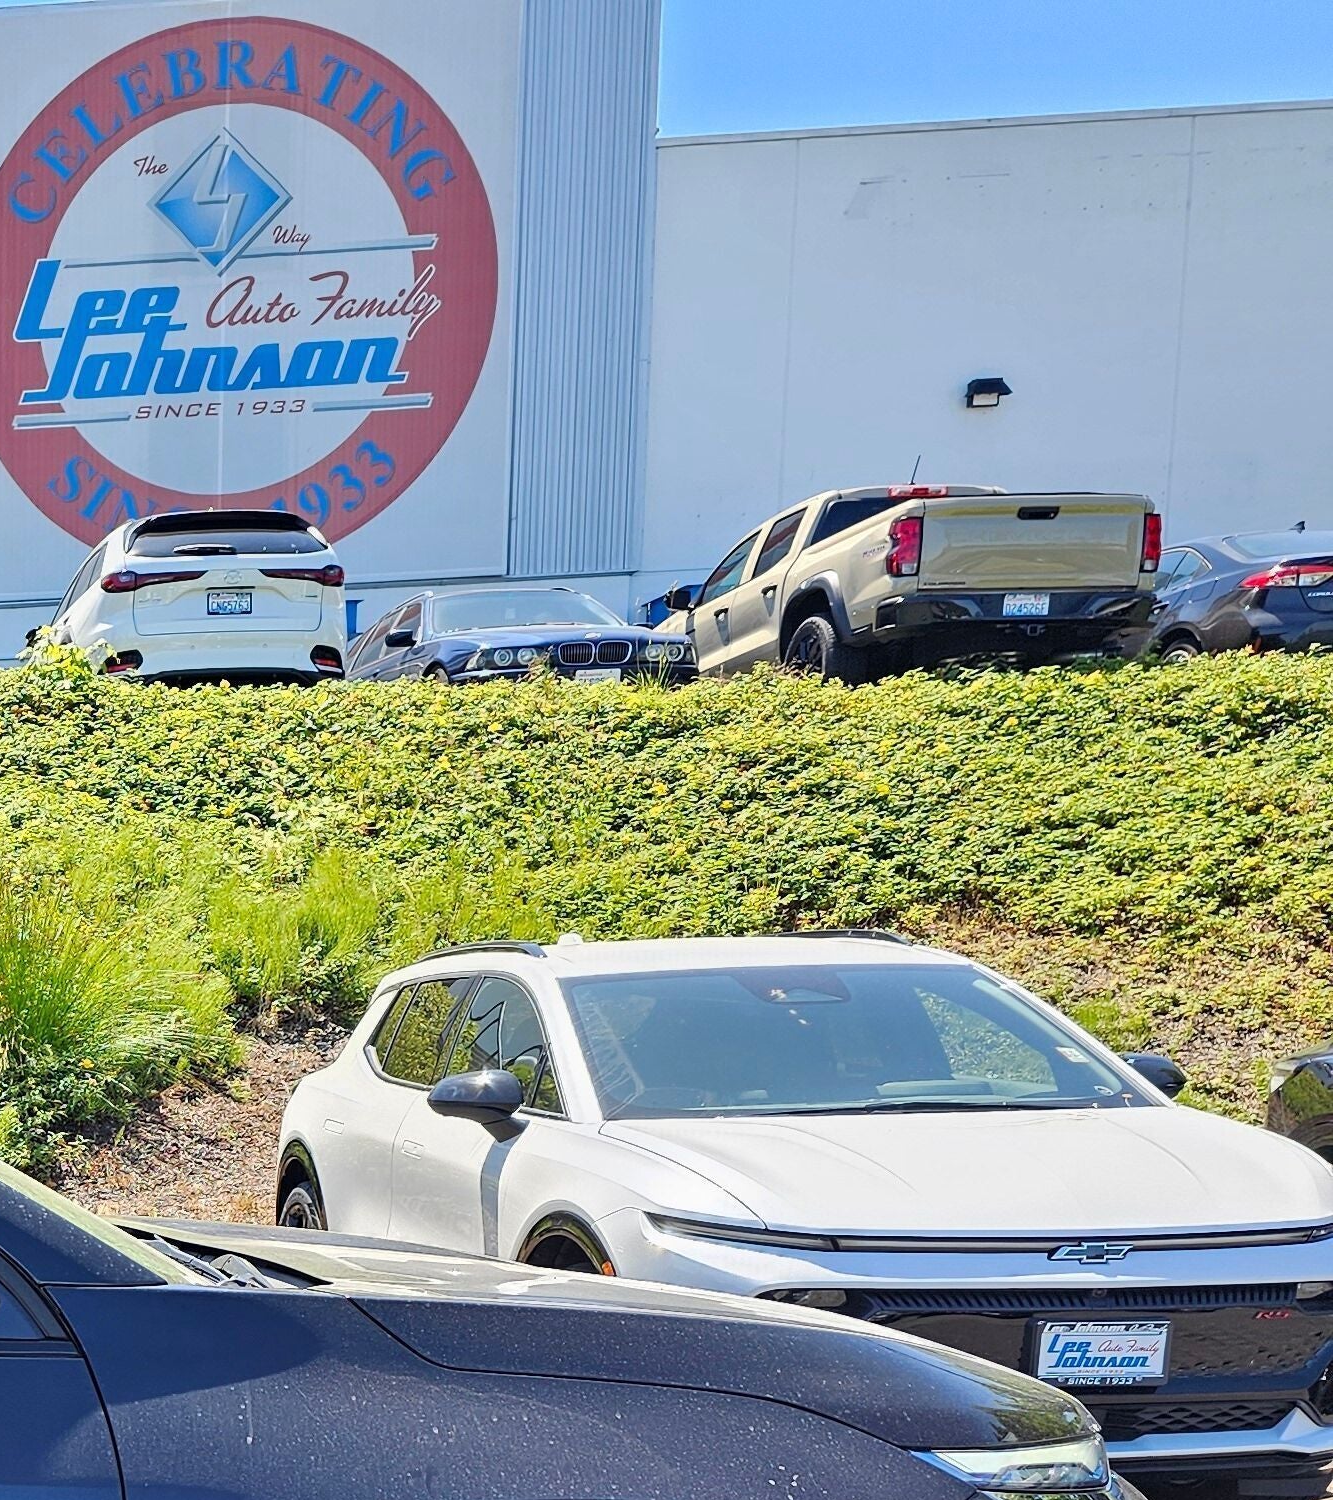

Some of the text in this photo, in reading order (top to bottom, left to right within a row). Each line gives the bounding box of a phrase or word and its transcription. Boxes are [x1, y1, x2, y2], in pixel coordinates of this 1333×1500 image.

[7, 40, 456, 225] CELEBRATING
[133, 155, 169, 177] The
[272, 224, 312, 252] Way
[15, 260, 440, 341] Lee Auto Family
[19, 322, 409, 404] Johnson
[135, 399, 306, 421] SINCE 1933
[1047, 1334, 1092, 1353] Lee
[1047, 1346, 1151, 1369] Johnson
[1067, 1377, 1134, 1385] SINCE 1933
